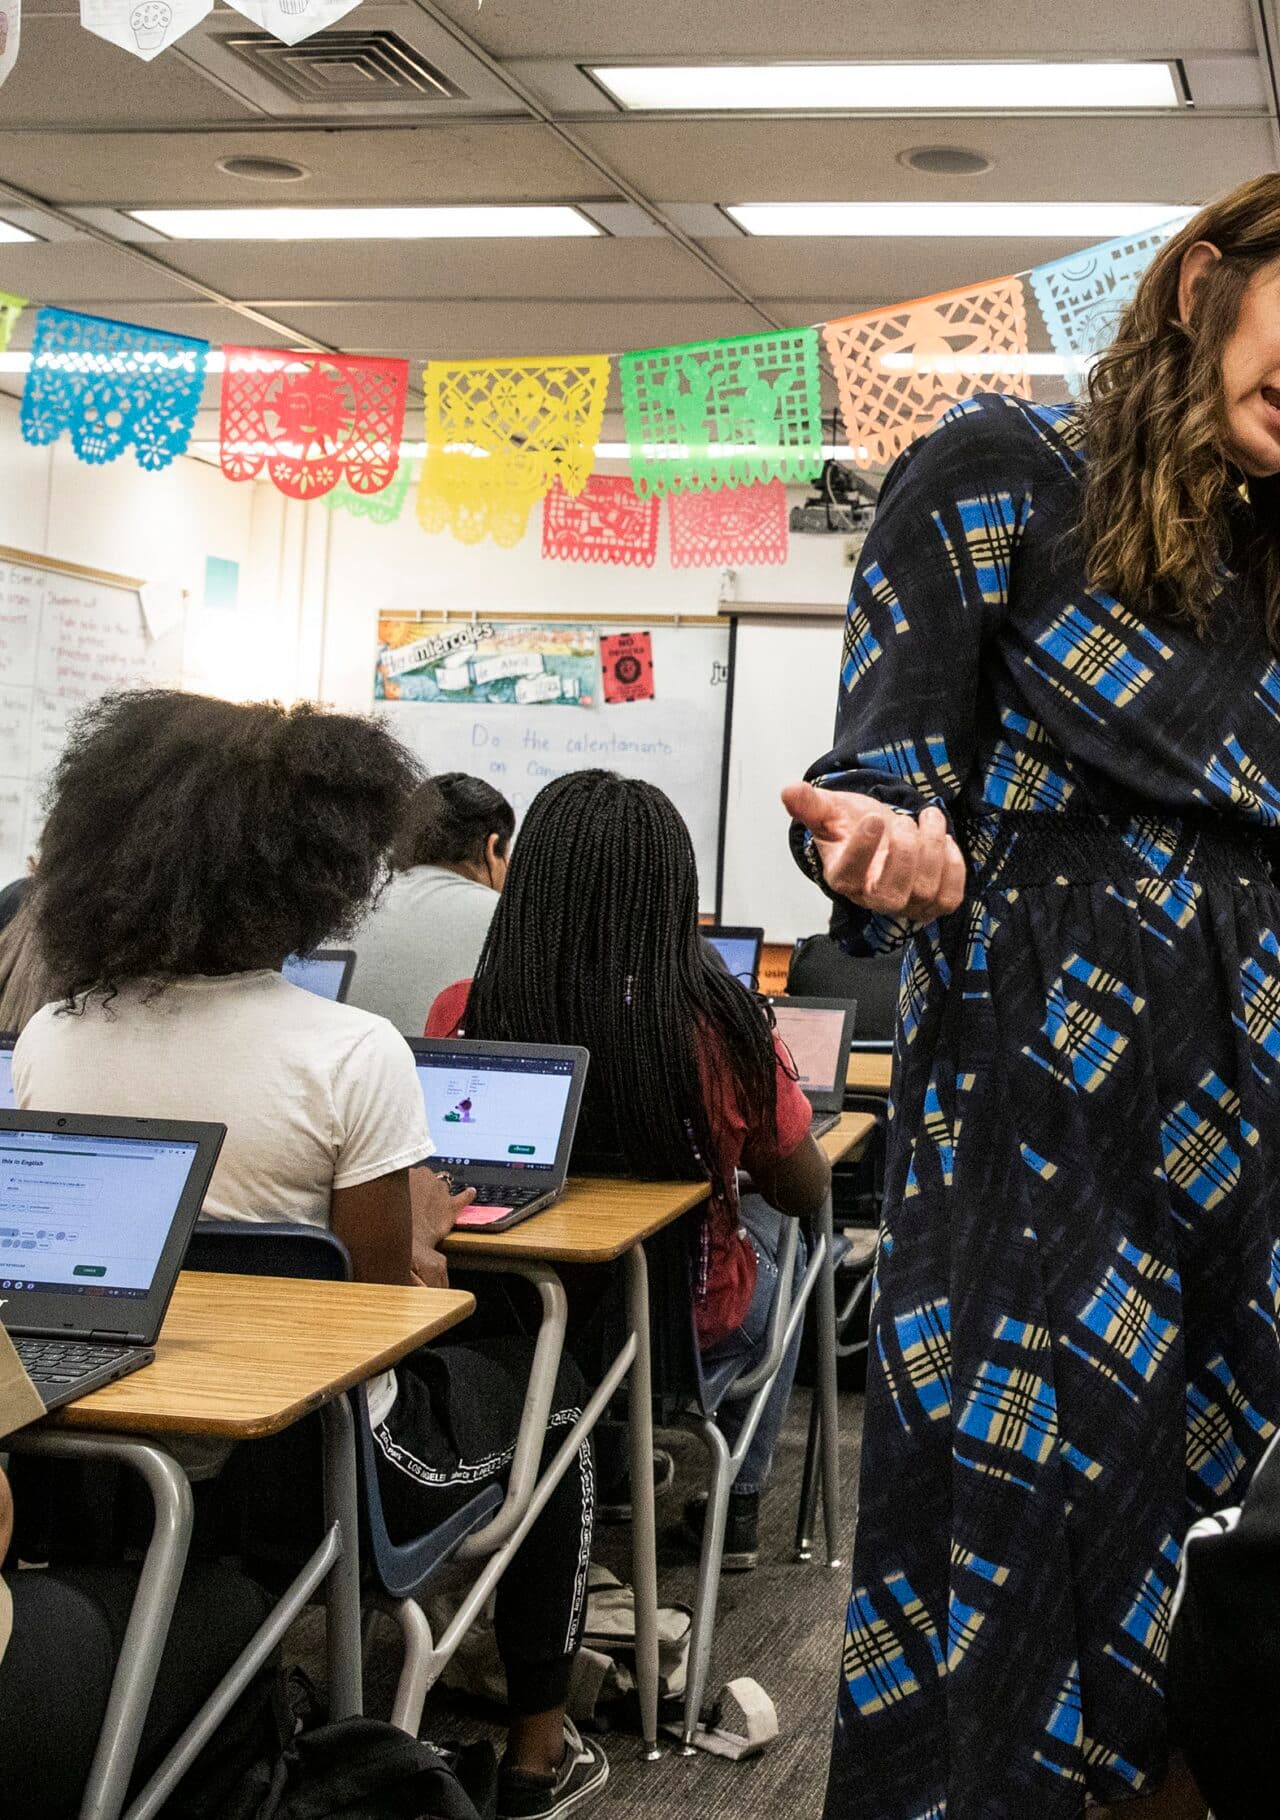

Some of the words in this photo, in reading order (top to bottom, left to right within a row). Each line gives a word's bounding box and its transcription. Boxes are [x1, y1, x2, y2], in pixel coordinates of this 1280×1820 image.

[618, 639, 634, 647] NO
[471, 723, 500, 748] Do
[522, 728, 550, 752] the
[407, 1460, 423, 1475] LOS
